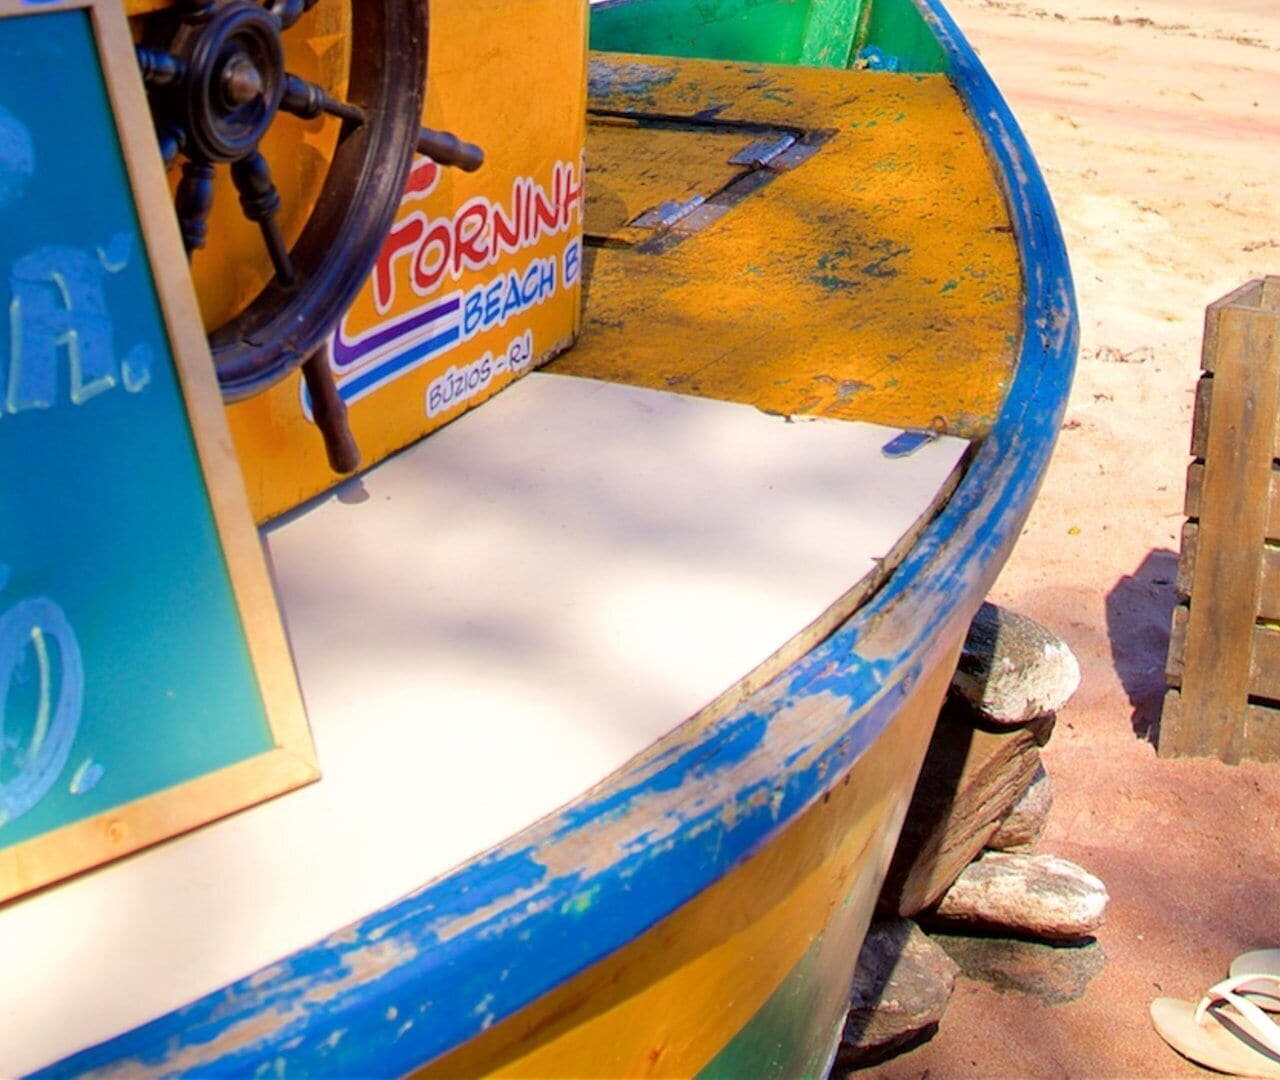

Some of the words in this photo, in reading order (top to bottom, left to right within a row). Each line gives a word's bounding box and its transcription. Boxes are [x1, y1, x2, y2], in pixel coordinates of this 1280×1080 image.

[463, 261, 554, 335] BEACH
[429, 358, 490, 410] BÚZIOS
[510, 335, 530, 368] RJ
